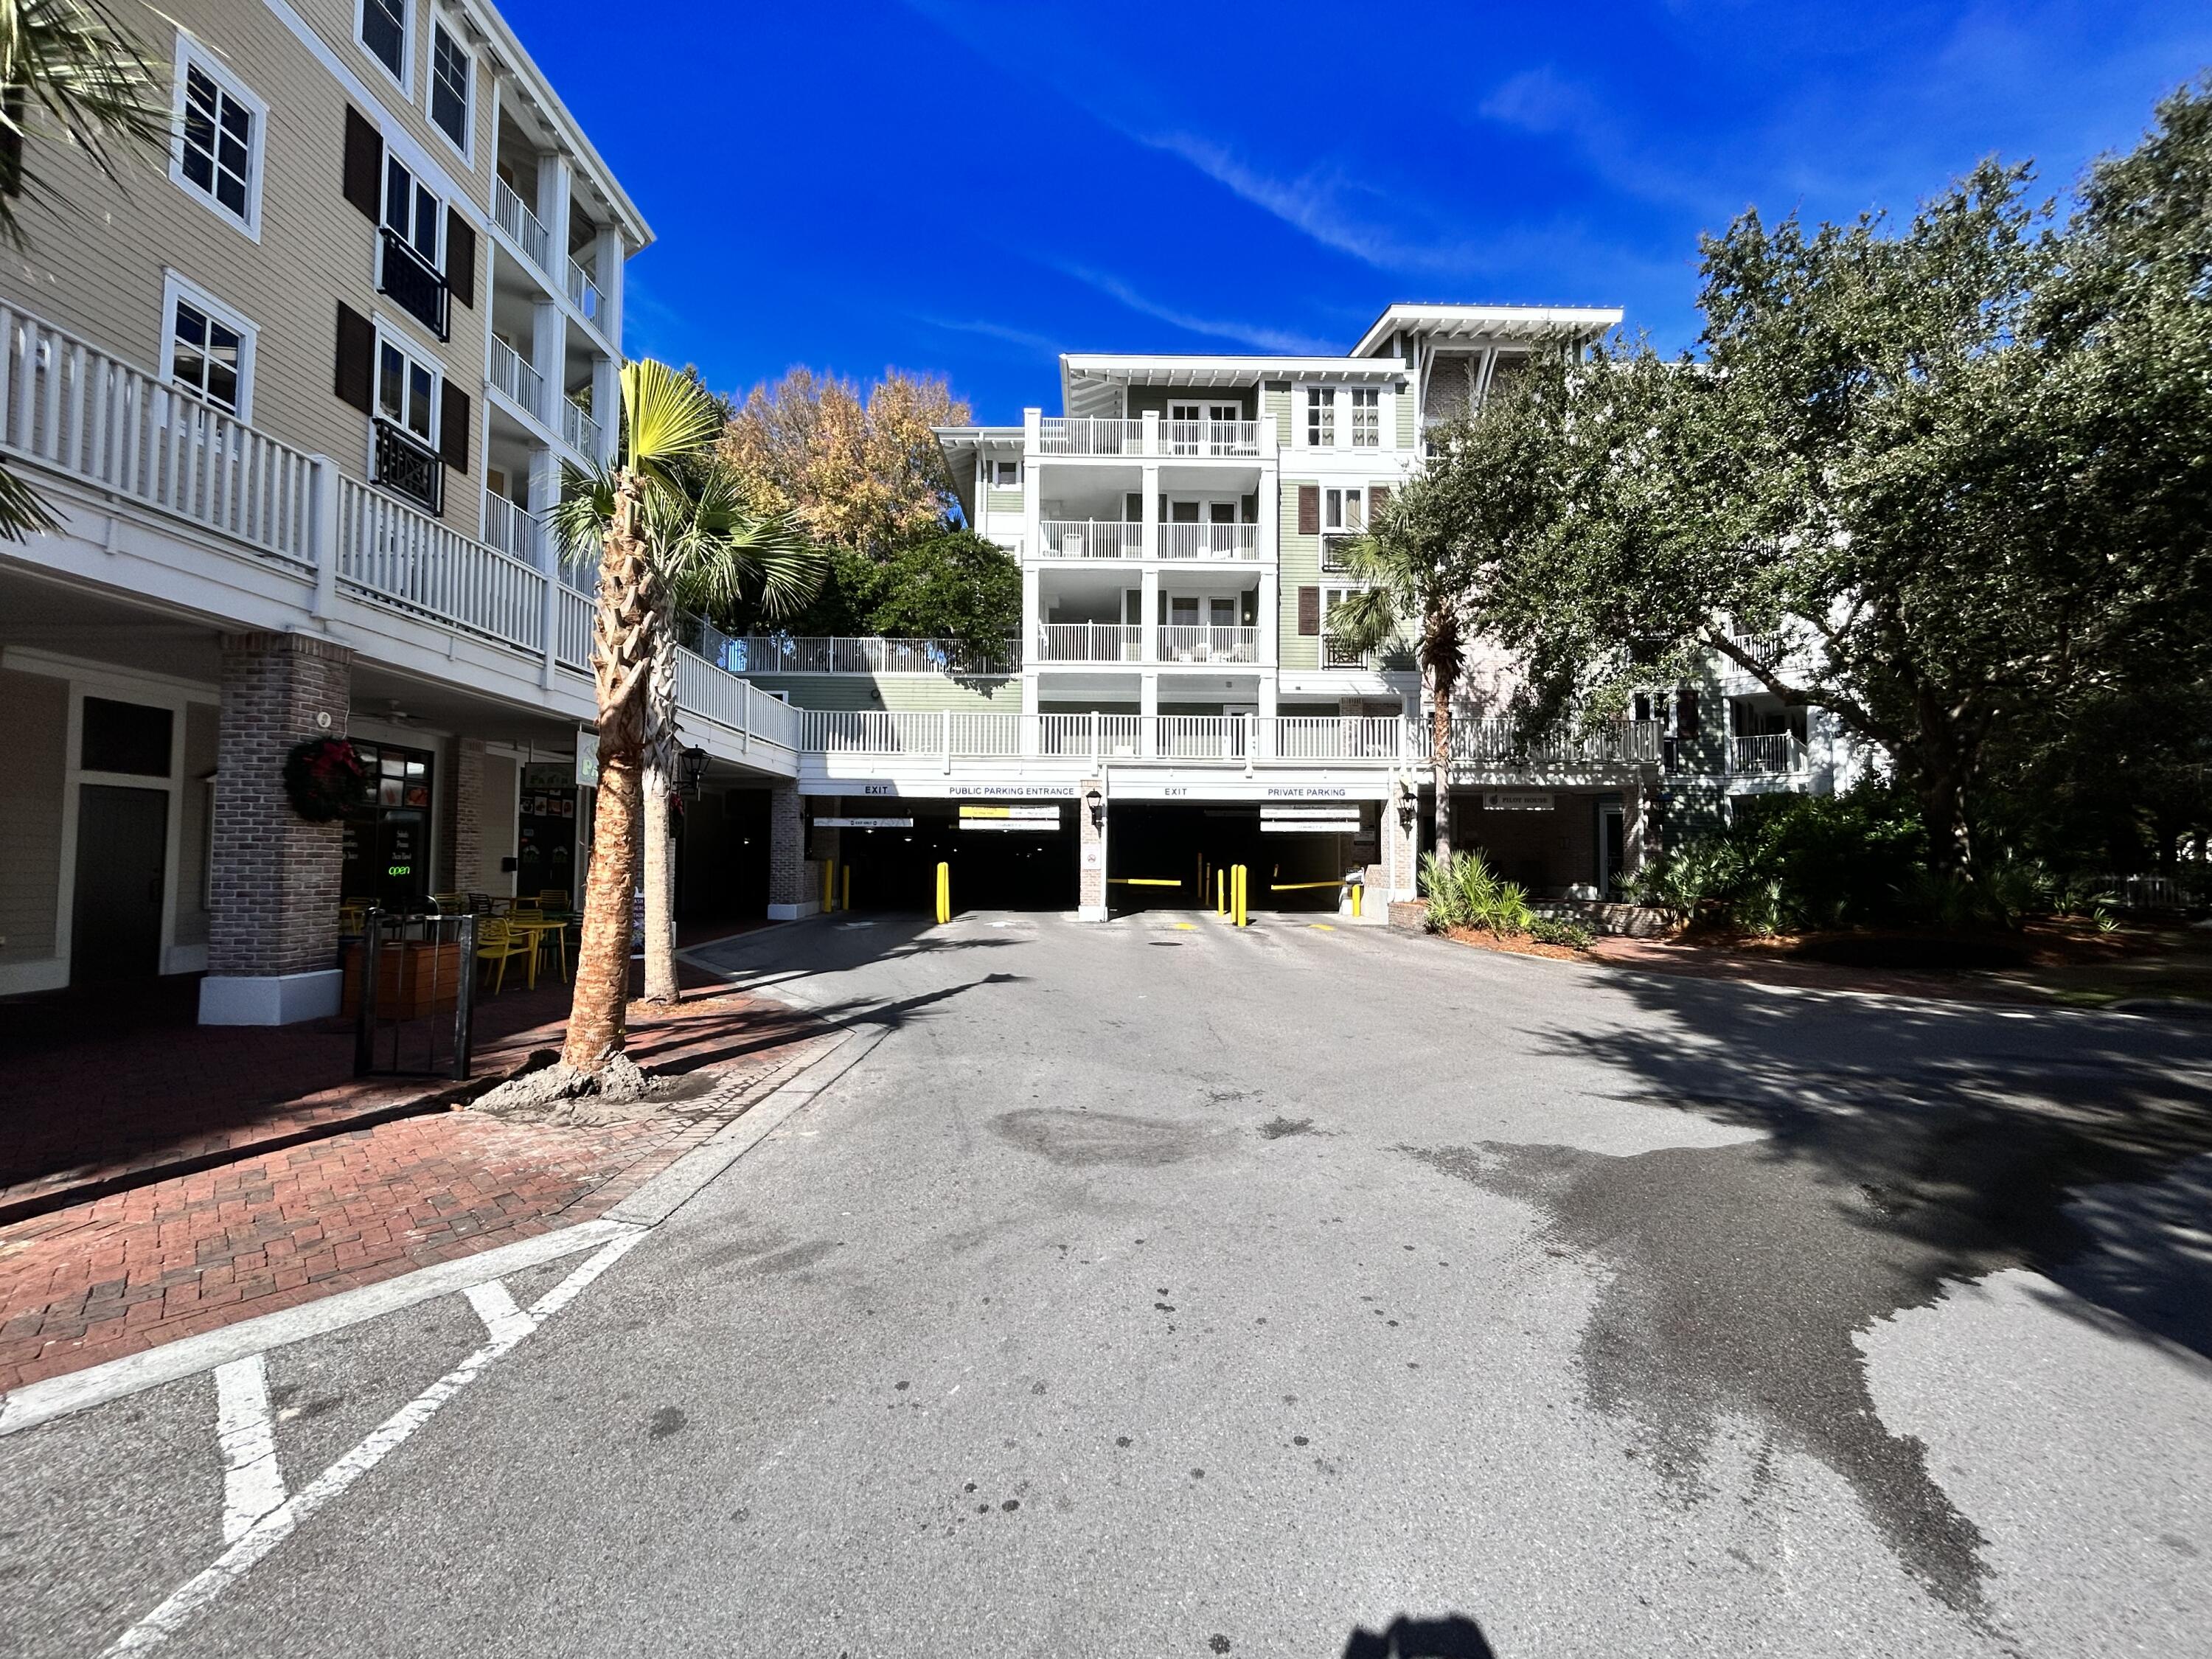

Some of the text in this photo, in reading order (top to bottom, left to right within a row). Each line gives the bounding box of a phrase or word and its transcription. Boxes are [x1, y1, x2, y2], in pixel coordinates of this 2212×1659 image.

[864, 786, 888, 794] EXIT
[949, 787, 1074, 796] PUBLIC PARKING ENTRANCE
[1267, 788, 1346, 796] PRIVATE PARKING
[388, 866, 411, 877] open
